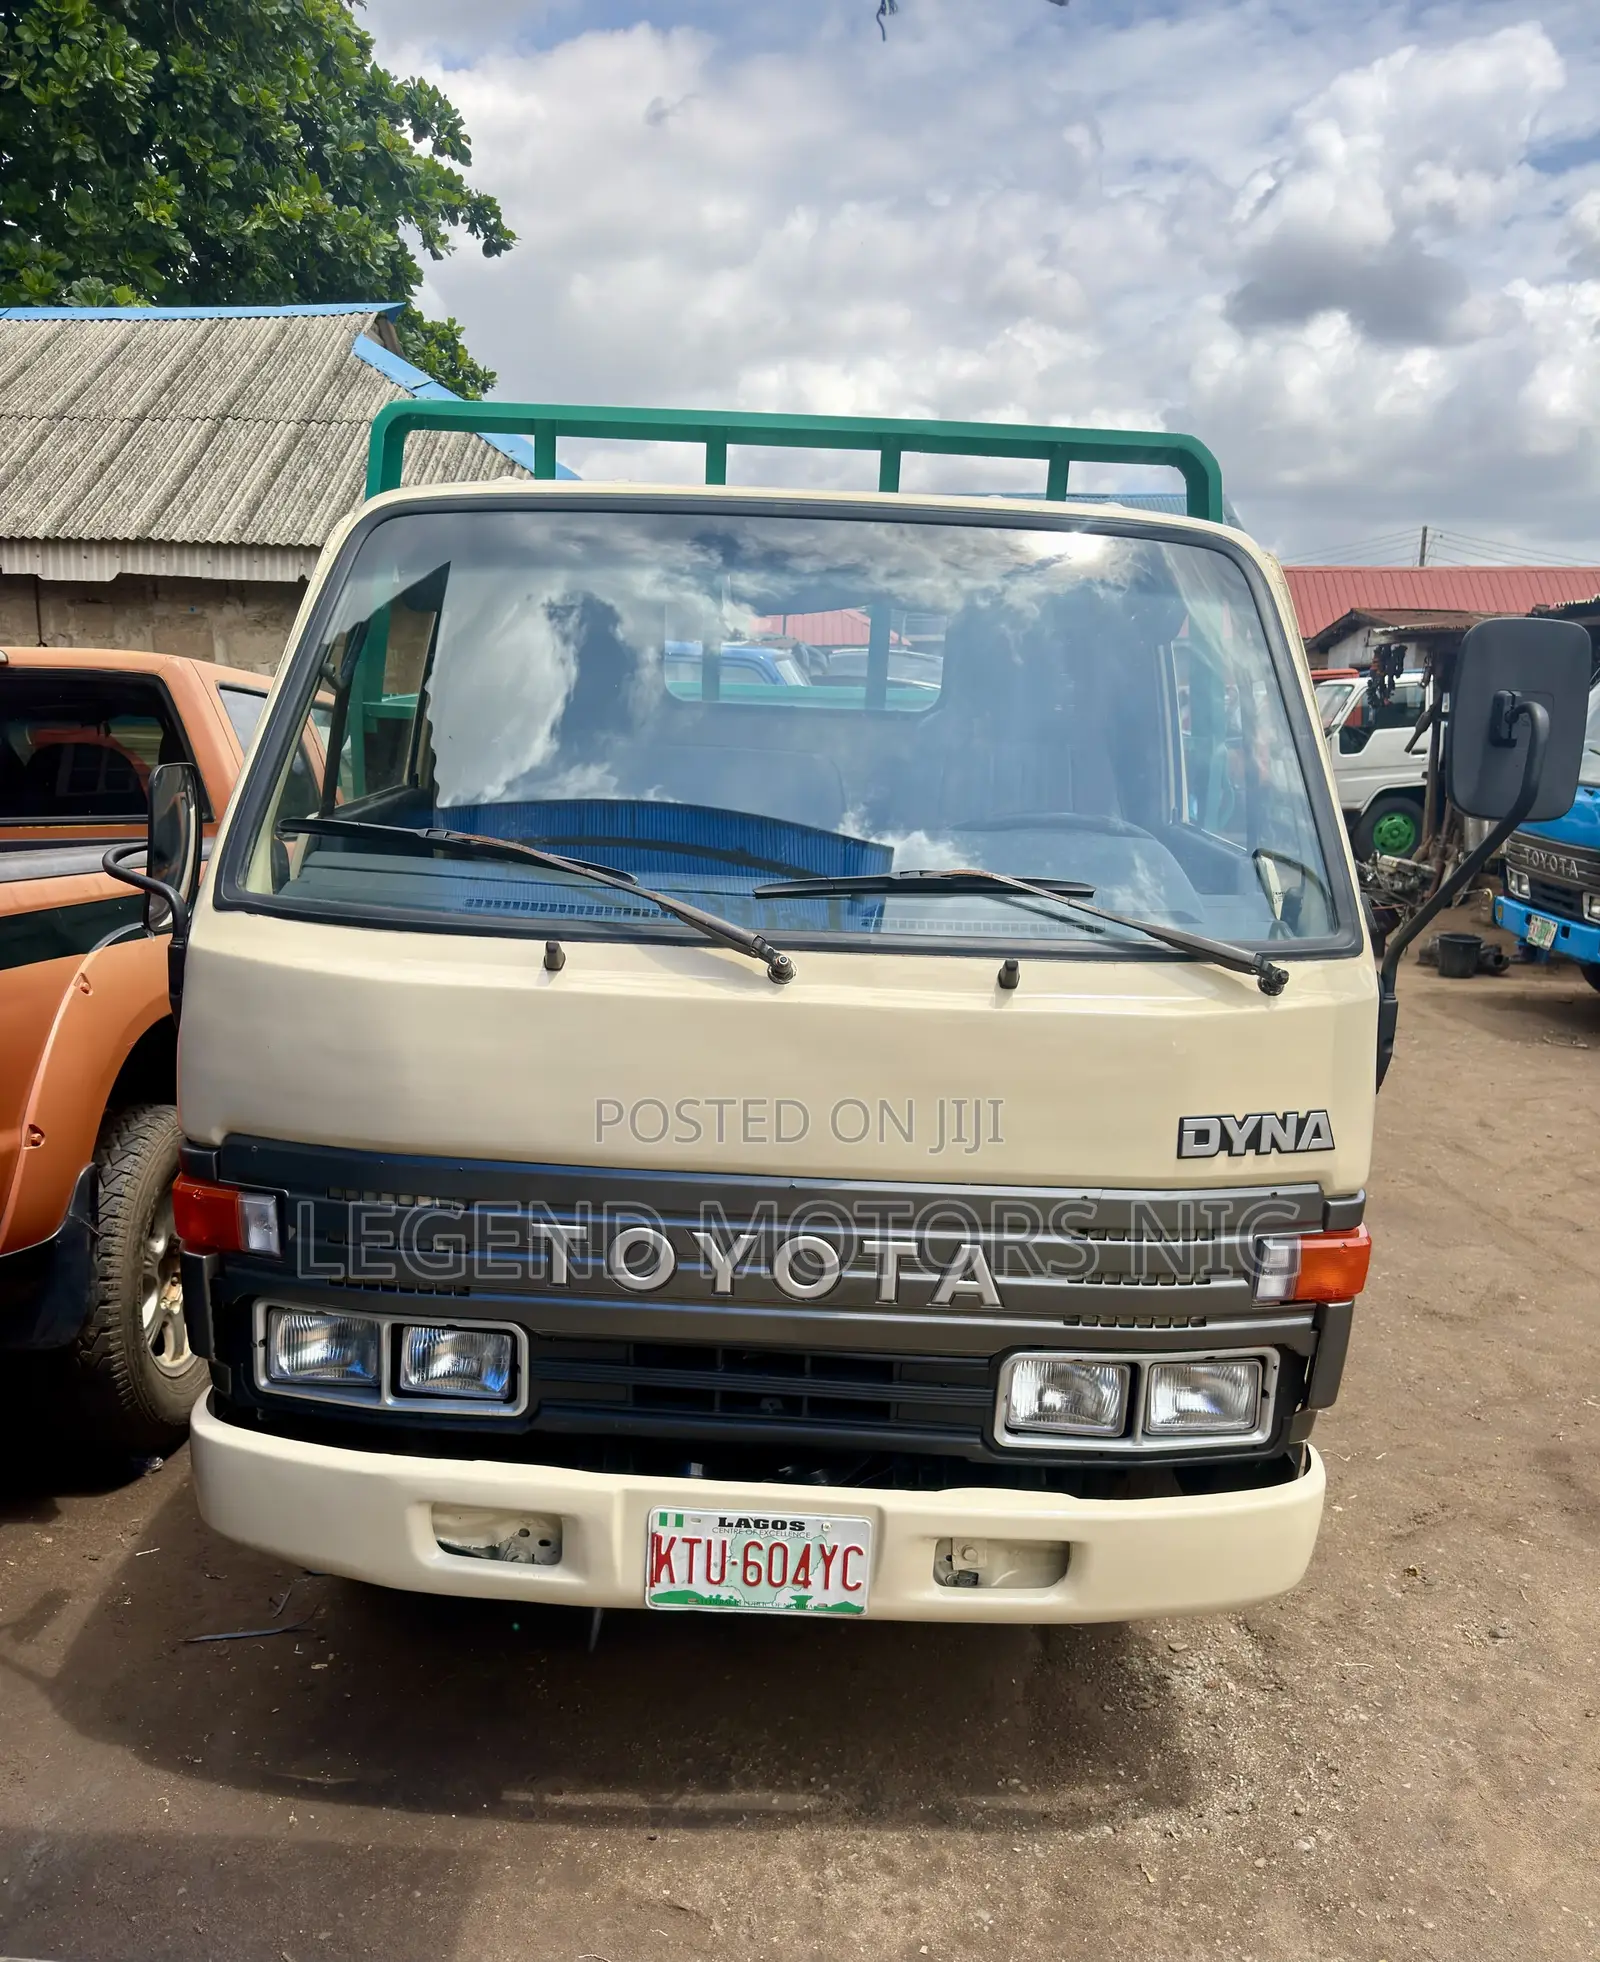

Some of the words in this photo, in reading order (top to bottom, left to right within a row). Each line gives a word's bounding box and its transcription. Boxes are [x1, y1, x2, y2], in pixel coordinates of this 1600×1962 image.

[1523, 847, 1579, 879] TOYOTA
[1177, 1109, 1336, 1159] DYNA
[528, 1222, 1005, 1308] TOYOTA
[718, 1516, 806, 1532] LAGOS
[760, 1530, 811, 1539] EXCELLENCE
[651, 1533, 864, 1591] KTU-604YC
